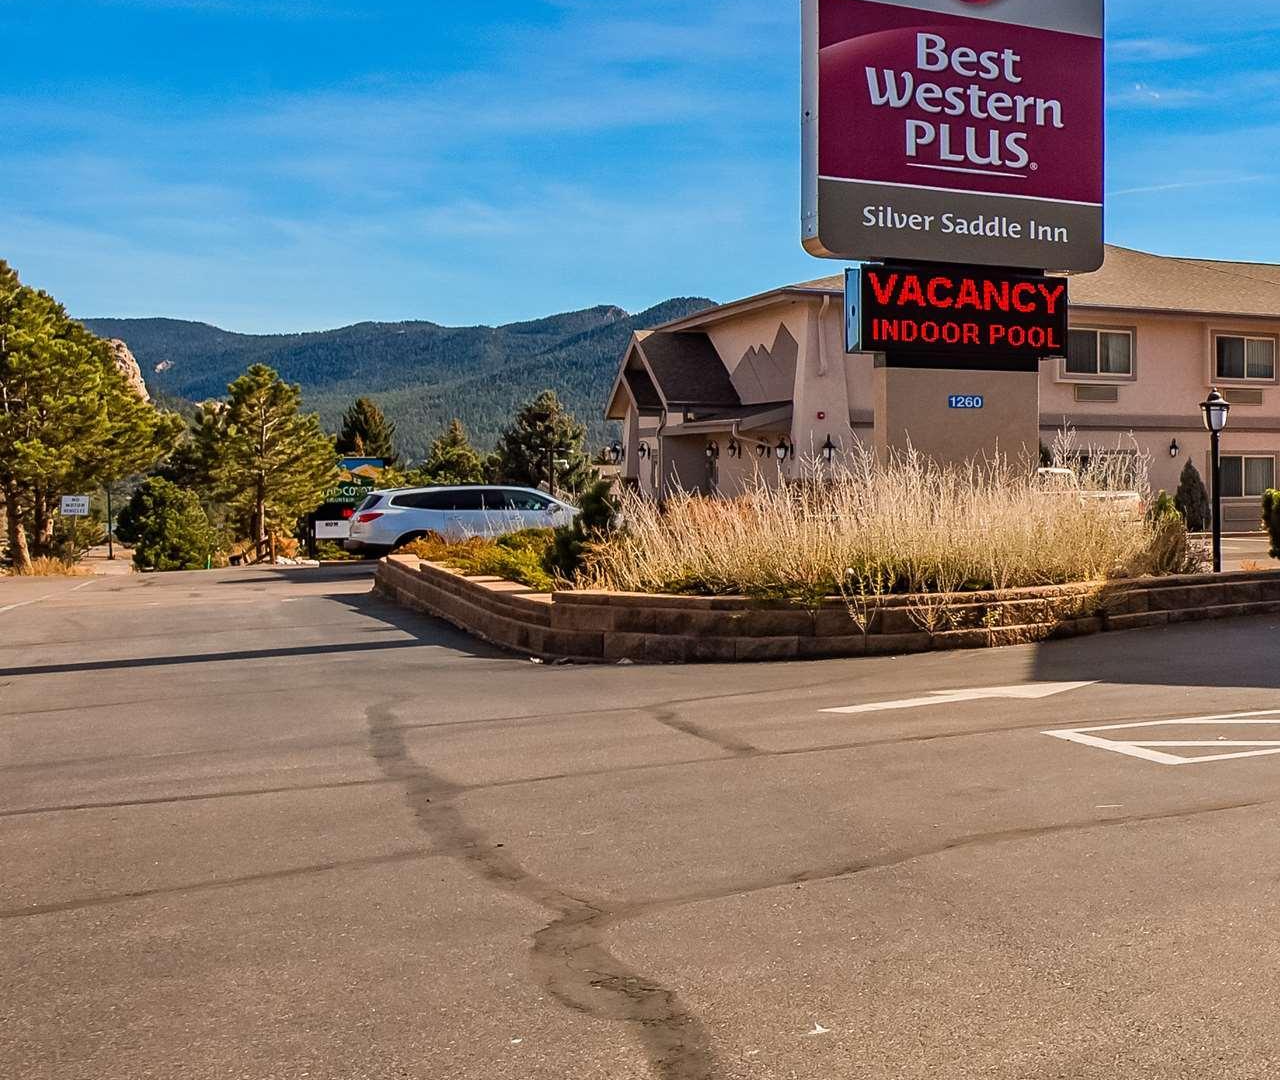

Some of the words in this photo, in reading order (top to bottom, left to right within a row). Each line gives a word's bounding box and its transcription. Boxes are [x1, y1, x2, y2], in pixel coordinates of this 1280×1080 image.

[916, 32, 1022, 83] Best
[865, 66, 1064, 128] Western
[905, 120, 1030, 170] PLUS
[862, 205, 934, 231] Silver
[941, 213, 1021, 238] Saddle
[1029, 220, 1069, 243] Inn
[868, 272, 1065, 314] VACANCY
[872, 319, 981, 345] INDOOR
[989, 324, 1061, 348] POOL
[949, 396, 982, 408] 1260
